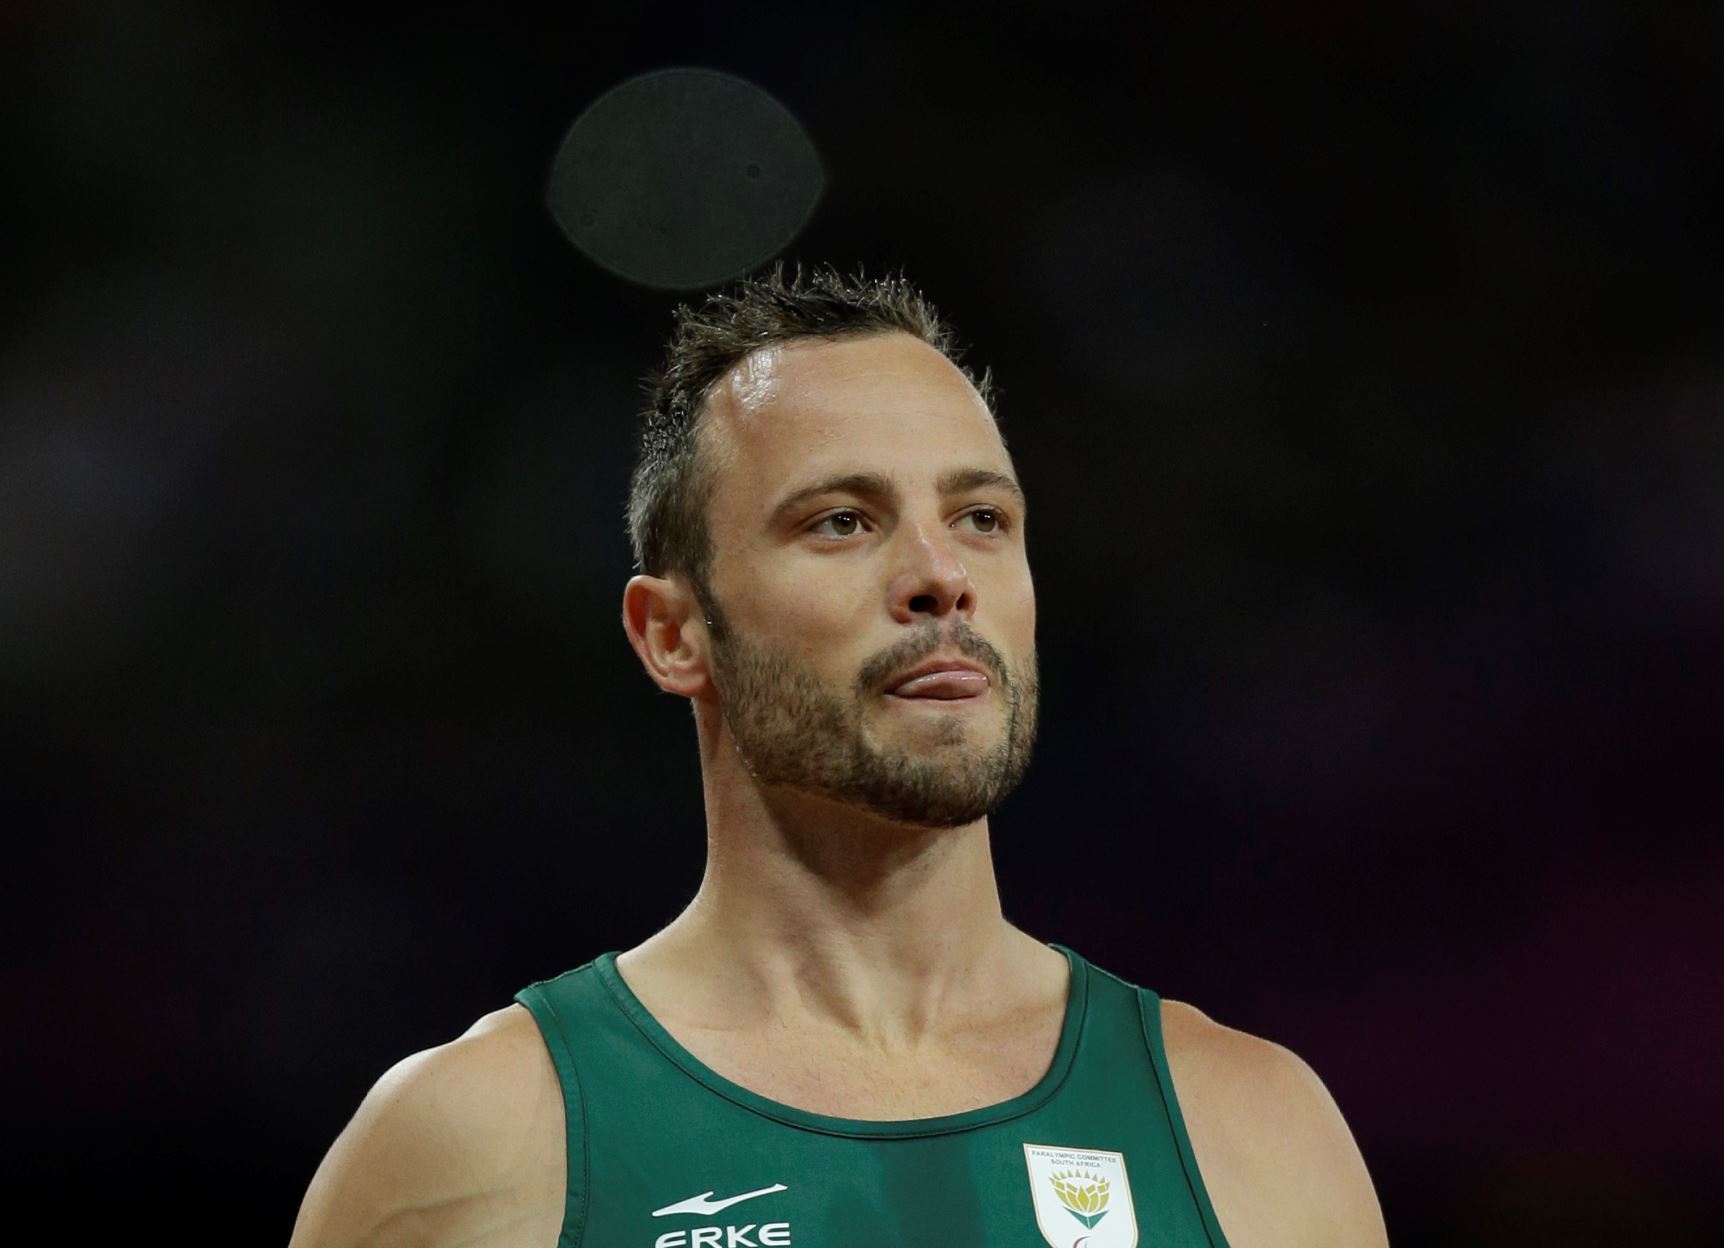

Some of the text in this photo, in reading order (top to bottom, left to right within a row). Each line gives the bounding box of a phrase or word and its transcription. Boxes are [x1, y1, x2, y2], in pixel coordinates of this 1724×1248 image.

[1031, 1150, 1075, 1160] PARALYMPIC
[1051, 1158, 1101, 1168] SOUTH AFRICA
